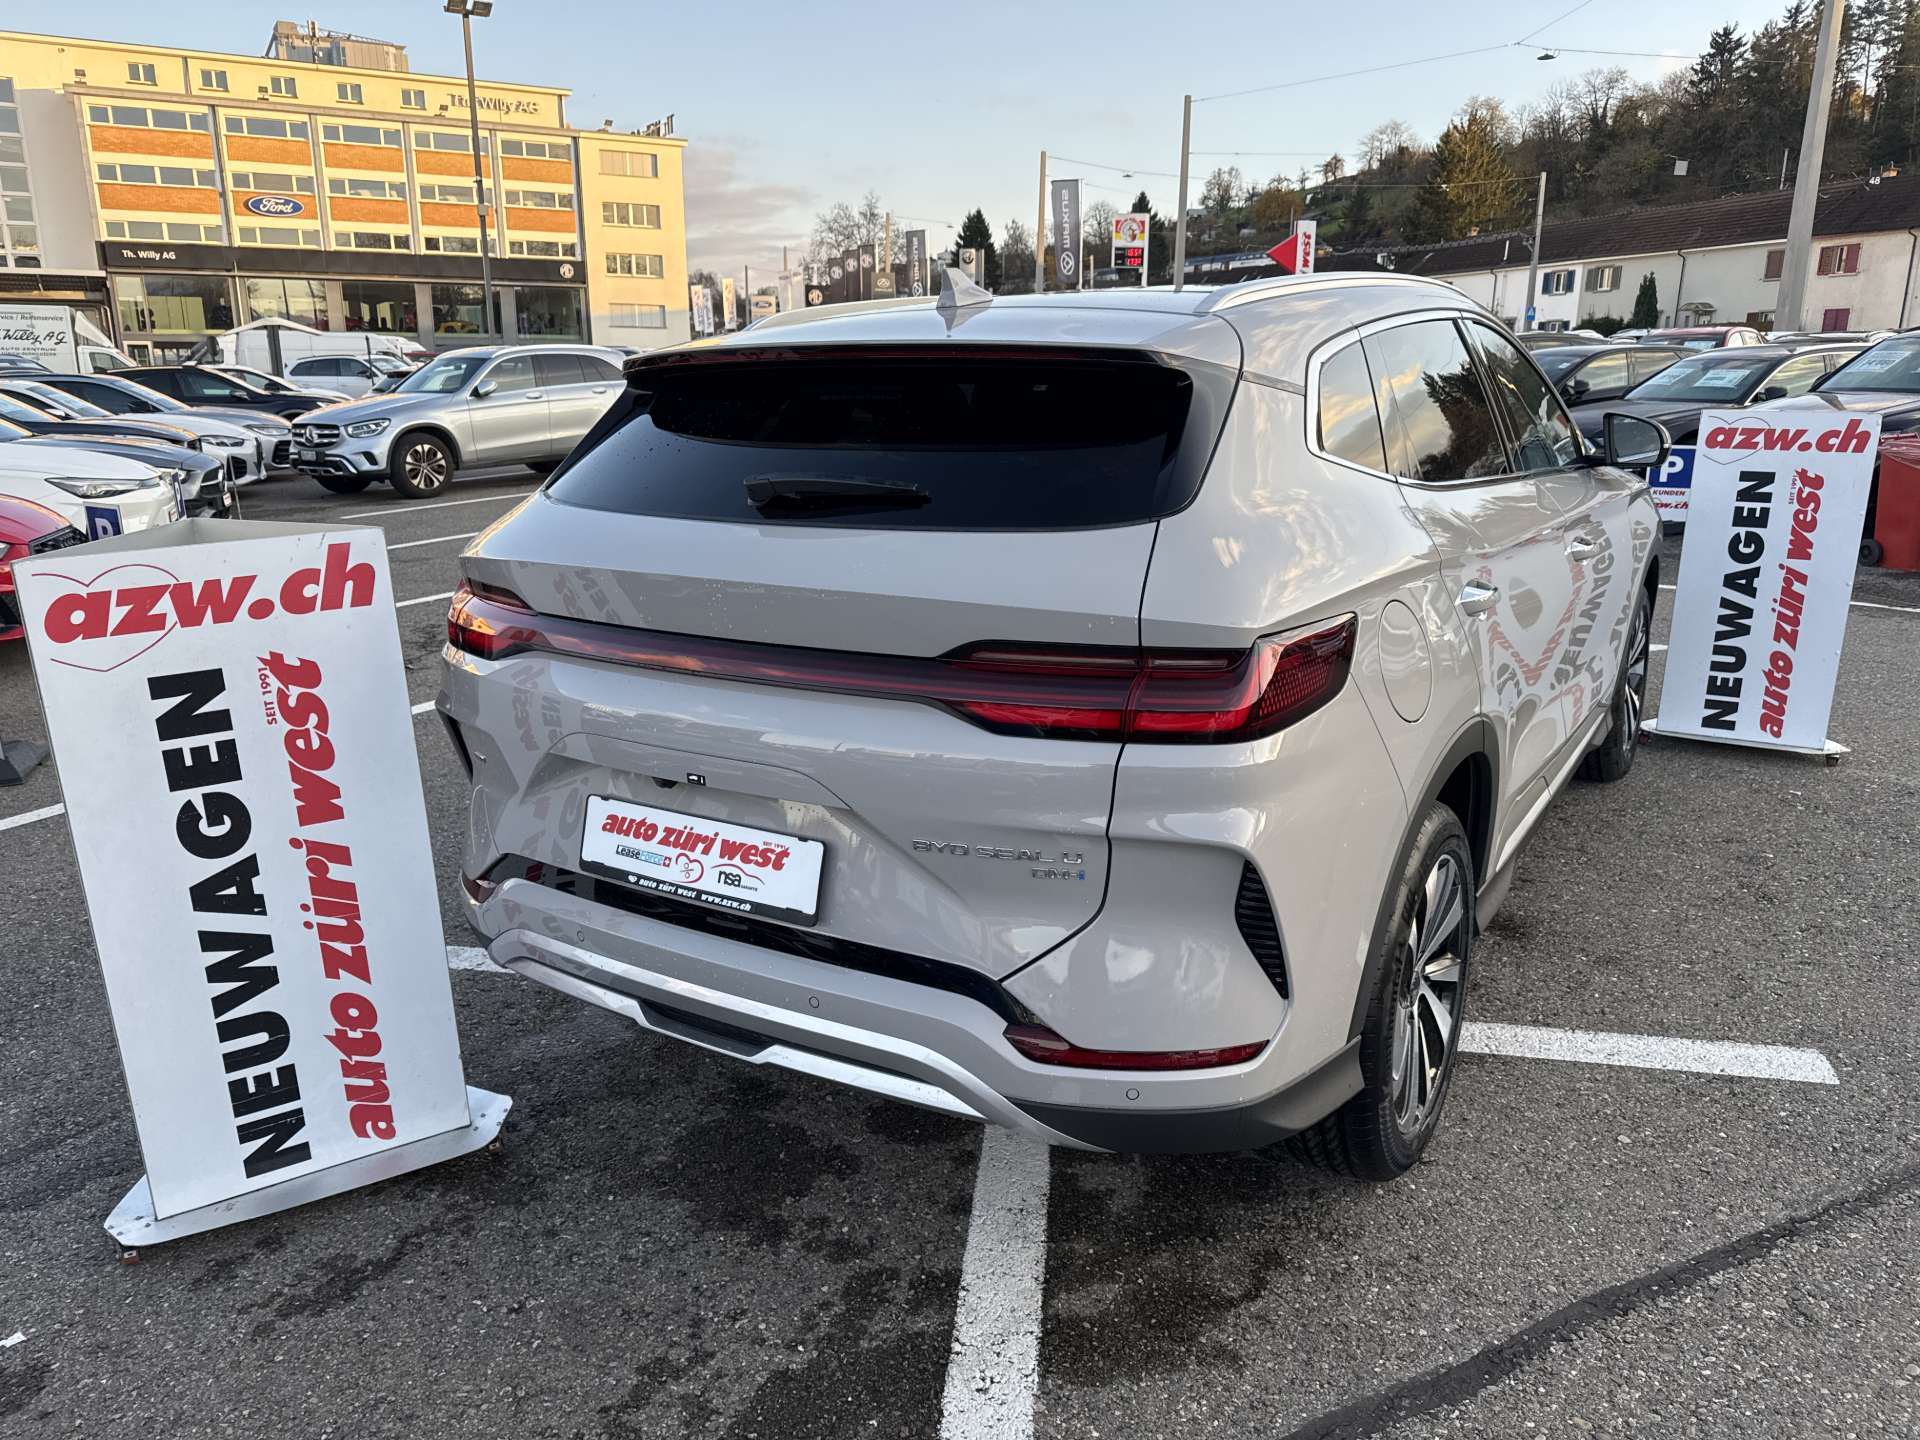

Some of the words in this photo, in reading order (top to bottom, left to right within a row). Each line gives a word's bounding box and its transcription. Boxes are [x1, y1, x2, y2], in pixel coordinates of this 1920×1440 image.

[479, 96, 512, 115] Willy
[516, 100, 540, 114] AG
[259, 198, 293, 213] Ford
[121, 249, 136, 258] Th.
[137, 250, 161, 261] Willy
[162, 251, 176, 260] AG
[3, 328, 42, 345] Willy
[43, 331, 67, 346] AG
[1706, 419, 1870, 453] azw.ch
[1659, 455, 1684, 483] P
[1786, 467, 1825, 561] west
[44, 543, 376, 644] azw.ch
[1701, 470, 1776, 731] NEUWAGEN
[1771, 563, 1808, 650] züri
[258, 667, 272, 696] 1991
[1759, 650, 1793, 739] auto
[264, 701, 277, 726] SEIT
[256, 650, 345, 827] west
[602, 812, 658, 842] auto
[657, 825, 719, 856] züri
[720, 837, 791, 871] west
[912, 839, 970, 856] BYD
[976, 845, 1056, 862] SEAL
[1063, 851, 1083, 864] U
[638, 878, 657, 888] auto
[658, 882, 676, 893] züri
[677, 887, 697, 898] west
[701, 893, 752, 912] www.azw.ch
[717, 870, 742, 888] nsa
[147, 668, 312, 1179] NEUWAGEN
[289, 837, 371, 983] züri
[325, 992, 396, 1140] auto
